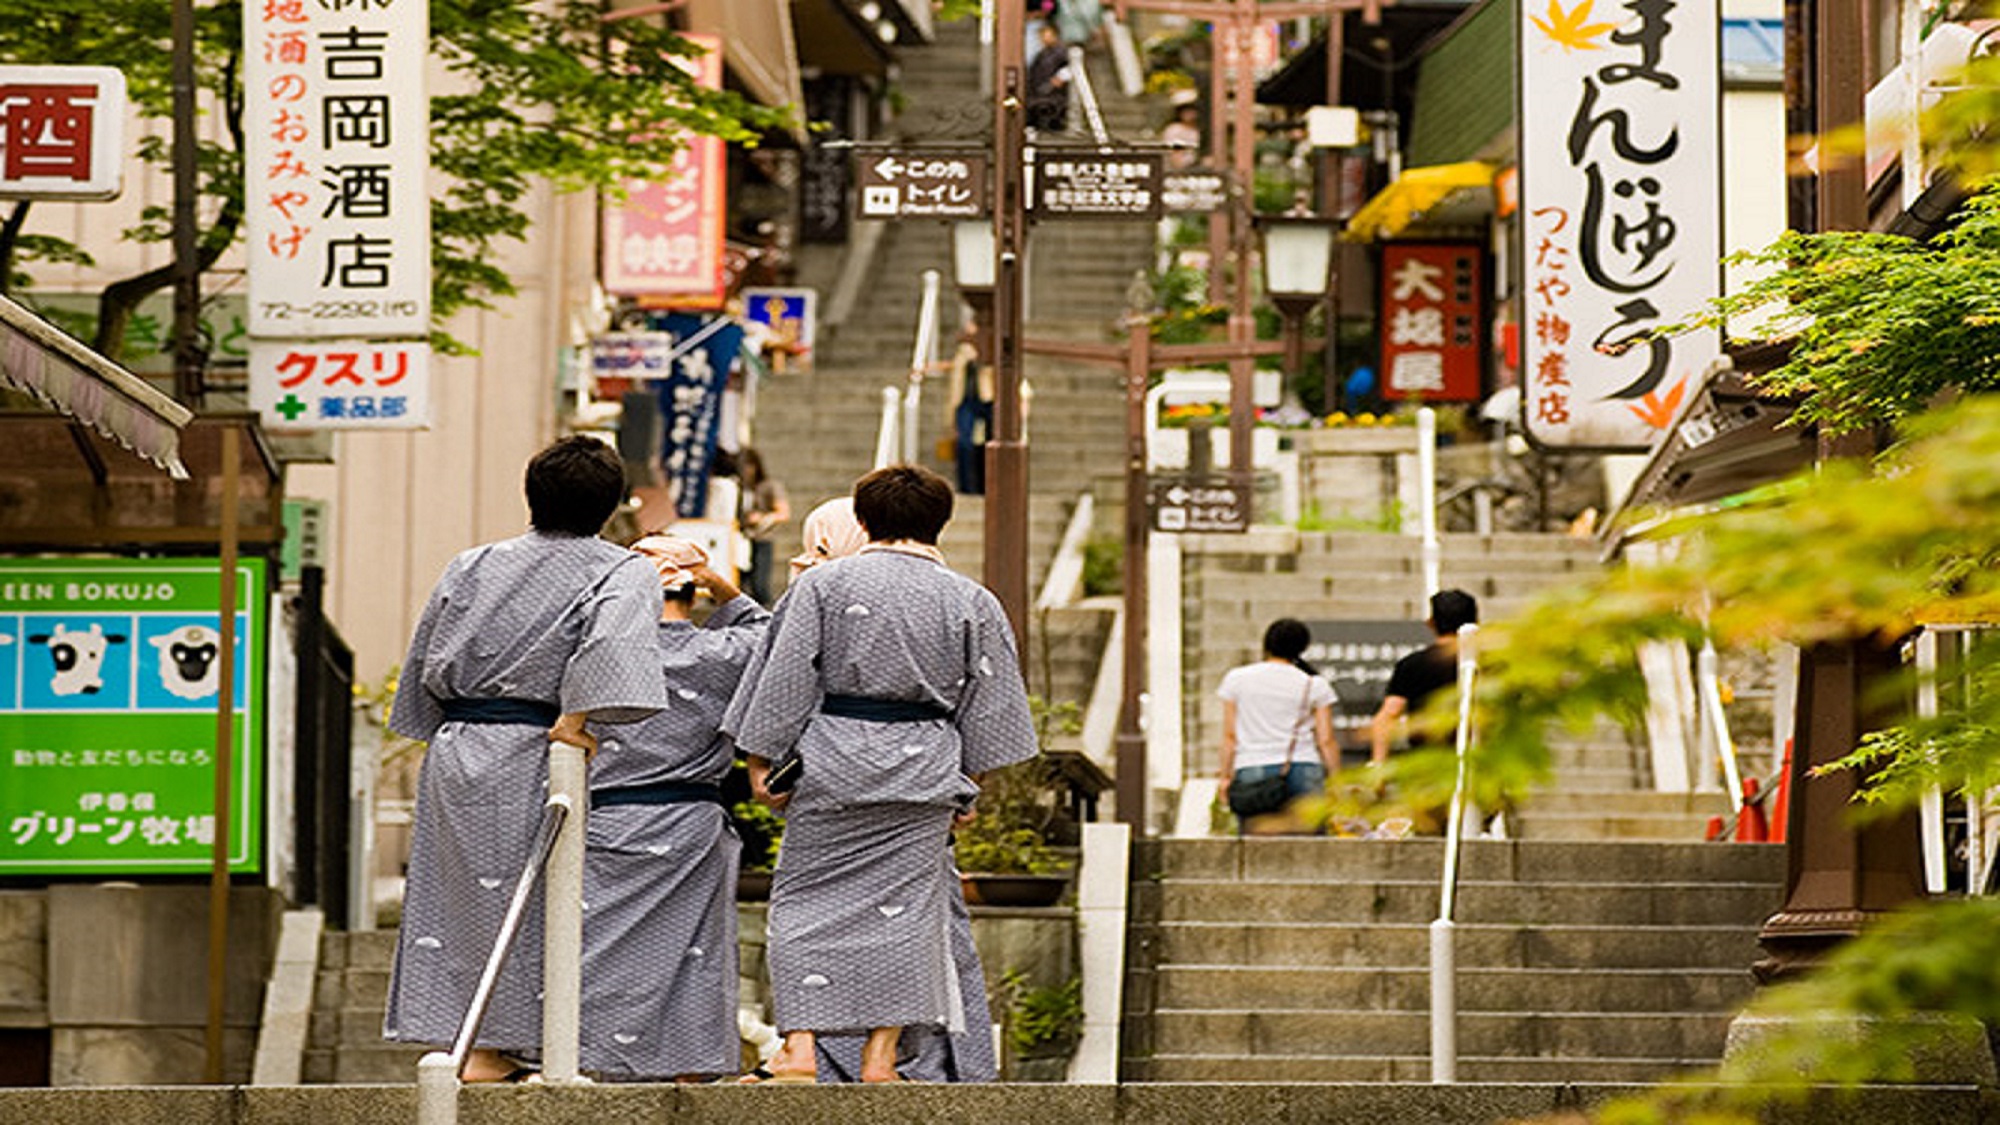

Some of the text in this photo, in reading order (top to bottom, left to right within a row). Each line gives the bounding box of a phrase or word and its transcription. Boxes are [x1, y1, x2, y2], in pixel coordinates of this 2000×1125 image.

[318, 26, 393, 288] 吉岡酒店
[906, 161, 969, 178] この先
[907, 183, 971, 203] トイレ
[1532, 206, 1571, 425] つたや物産店
[275, 351, 408, 389] クスリ
[319, 396, 408, 419] 薬品部
[65, 583, 175, 600] BOKUJO
[10, 811, 216, 845] グリーン牧場
